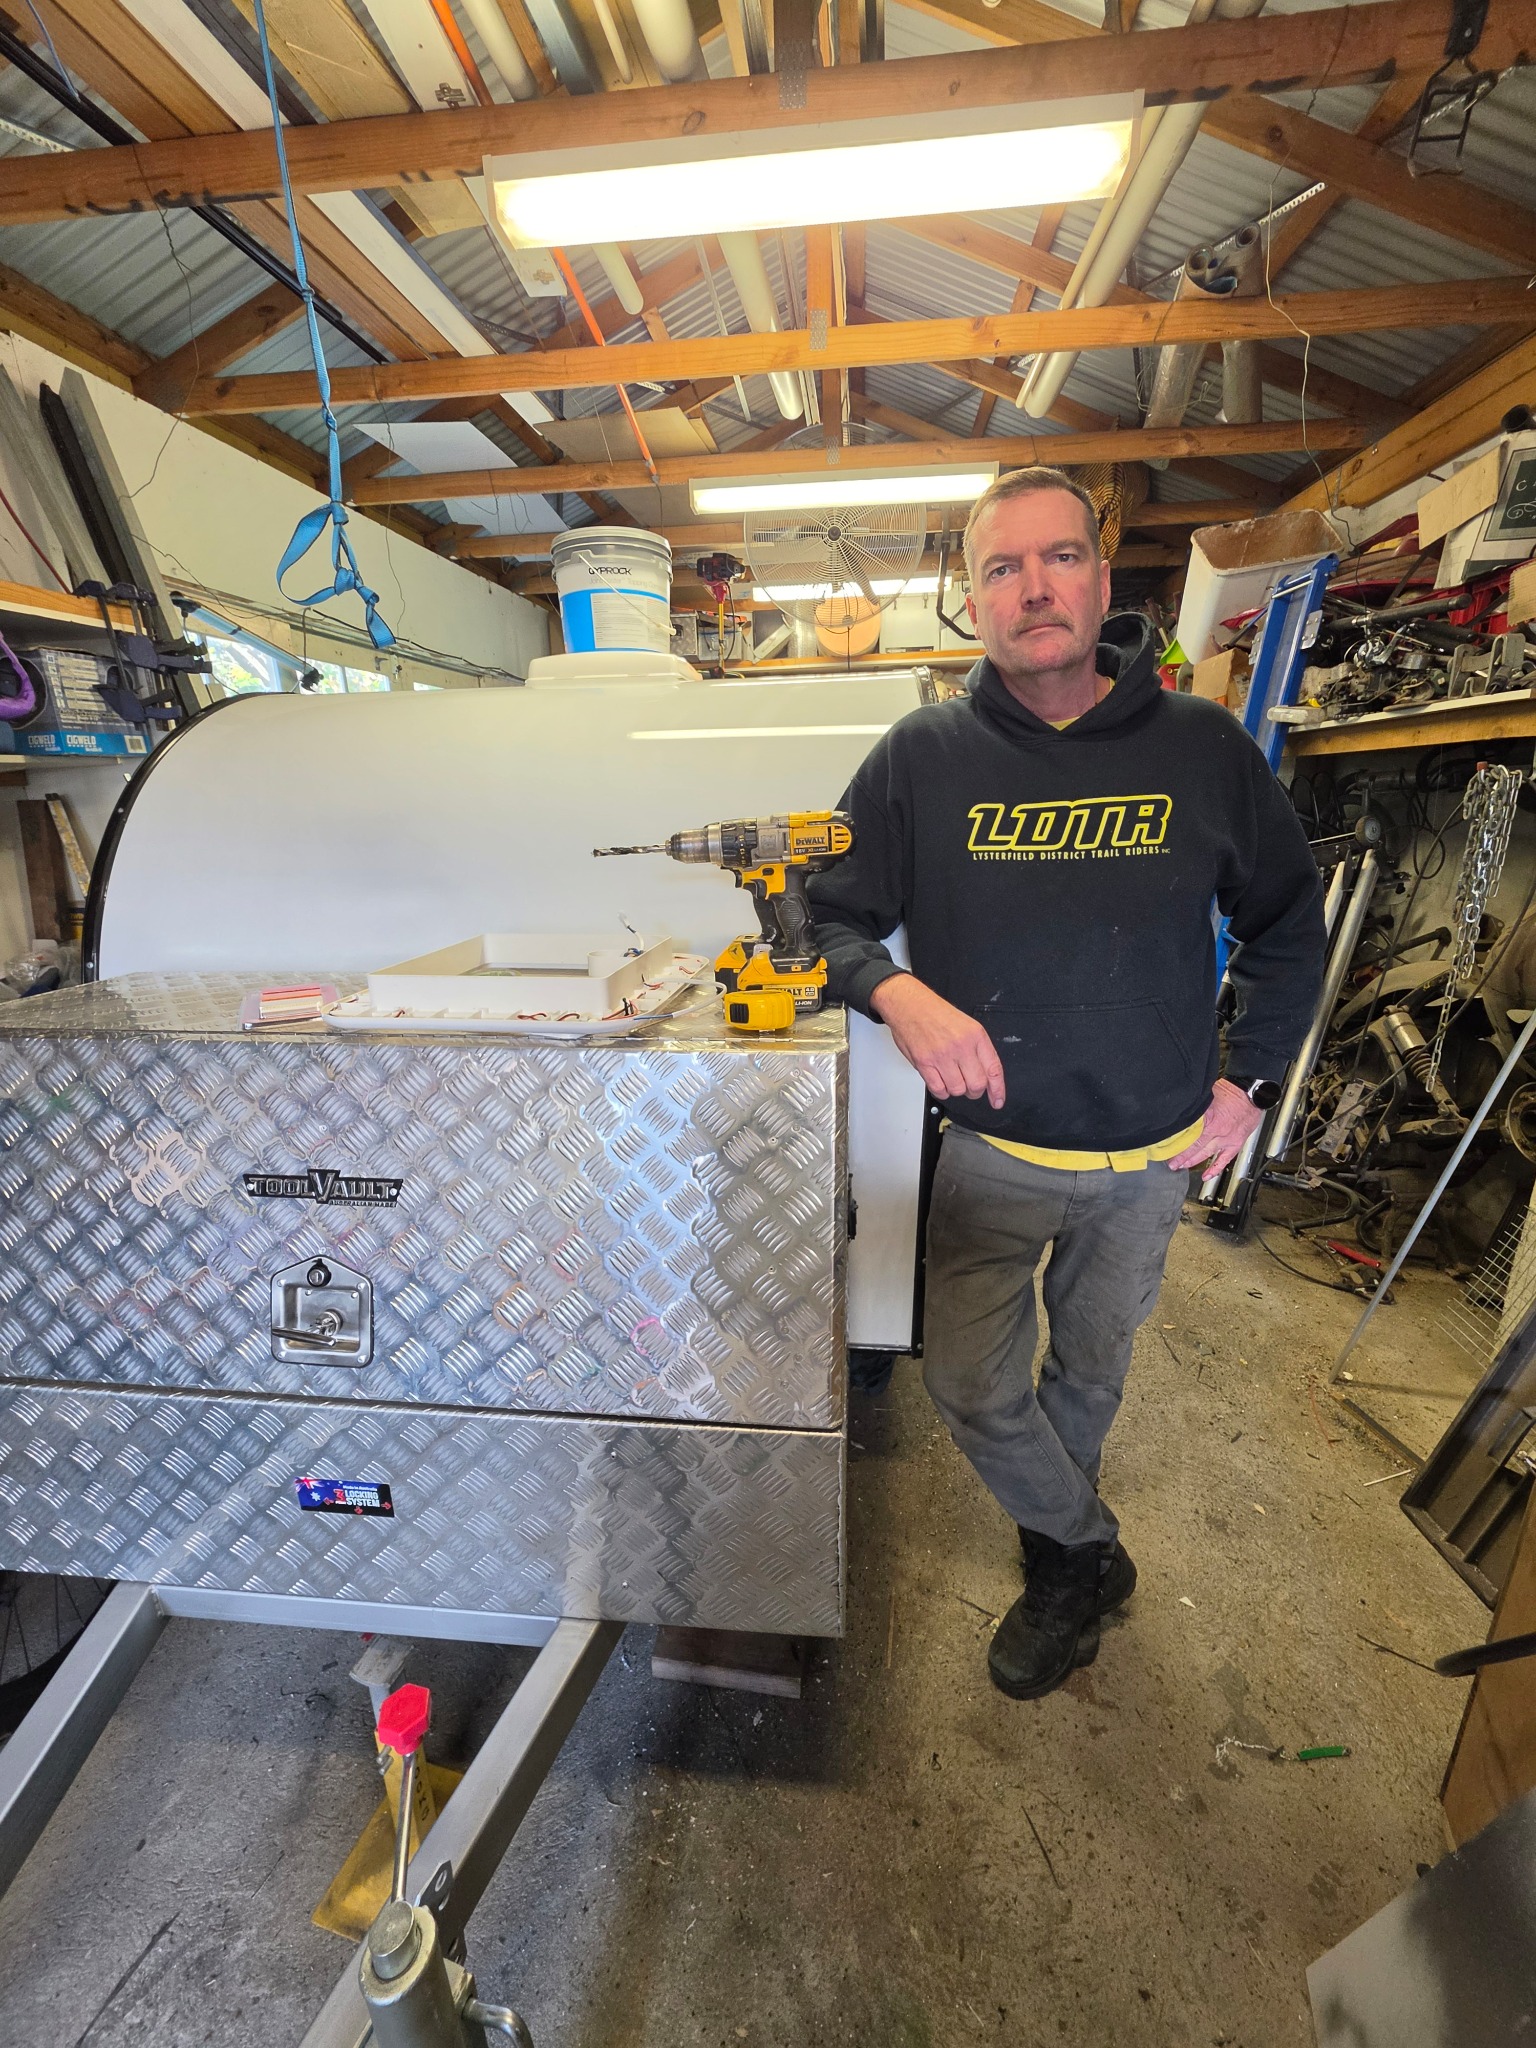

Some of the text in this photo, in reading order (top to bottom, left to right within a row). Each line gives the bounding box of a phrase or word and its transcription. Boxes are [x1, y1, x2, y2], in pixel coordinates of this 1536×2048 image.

[588, 566, 632, 575] GYPROCK
[28, 734, 56, 745] CIGWELD
[66, 735, 96, 745] CIGWELD
[967, 794, 1173, 851] LDTR
[973, 852, 1034, 861] LYSTERFIELD
[1040, 851, 1085, 860] DISTRICT
[1091, 848, 1120, 859] TRAIL
[1125, 846, 1160, 856] RIDERS
[345, 1490, 378, 1500] LOCKING
[346, 1498, 380, 1507] SYSTEM
